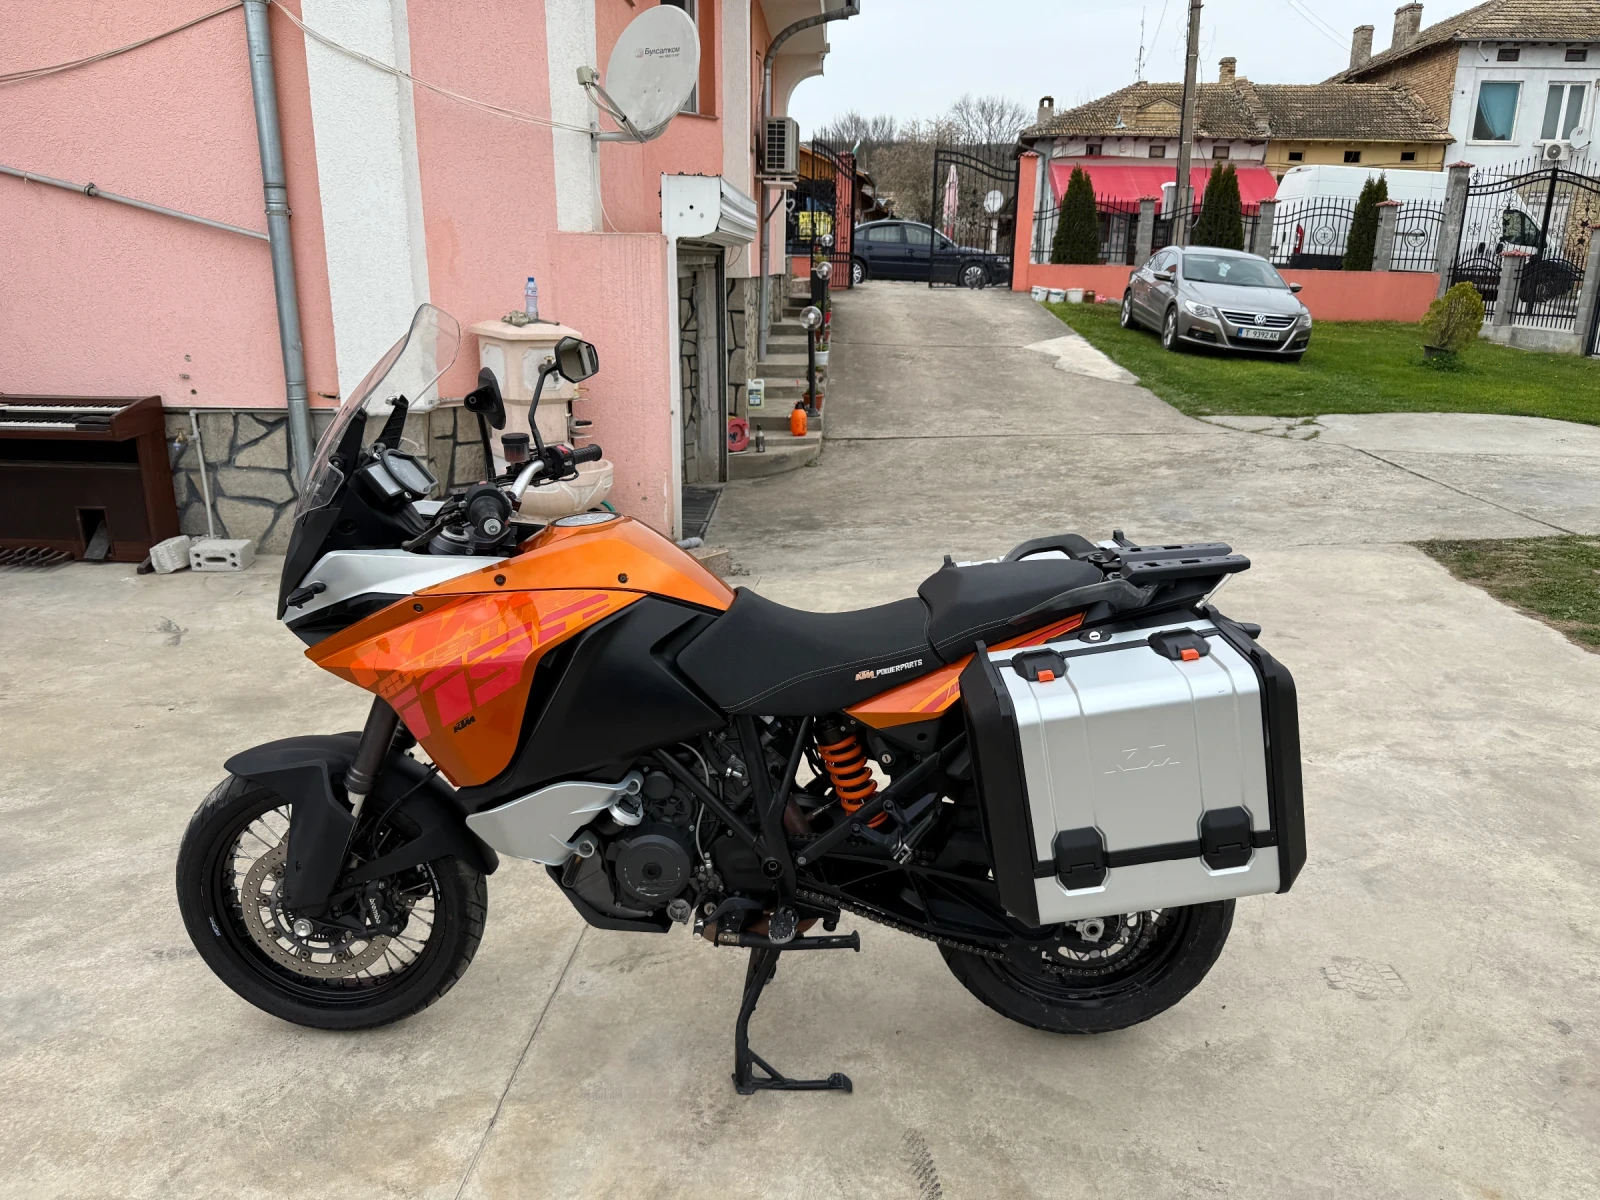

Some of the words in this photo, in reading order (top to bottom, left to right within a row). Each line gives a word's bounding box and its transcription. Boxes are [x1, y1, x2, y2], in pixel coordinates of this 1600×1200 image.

[1253, 330, 1269, 339] 9392
[855, 670, 874, 681] KTM
[876, 658, 923, 676] POWERPARTS
[453, 715, 476, 733] KTM
[368, 897, 382, 925] brembo
